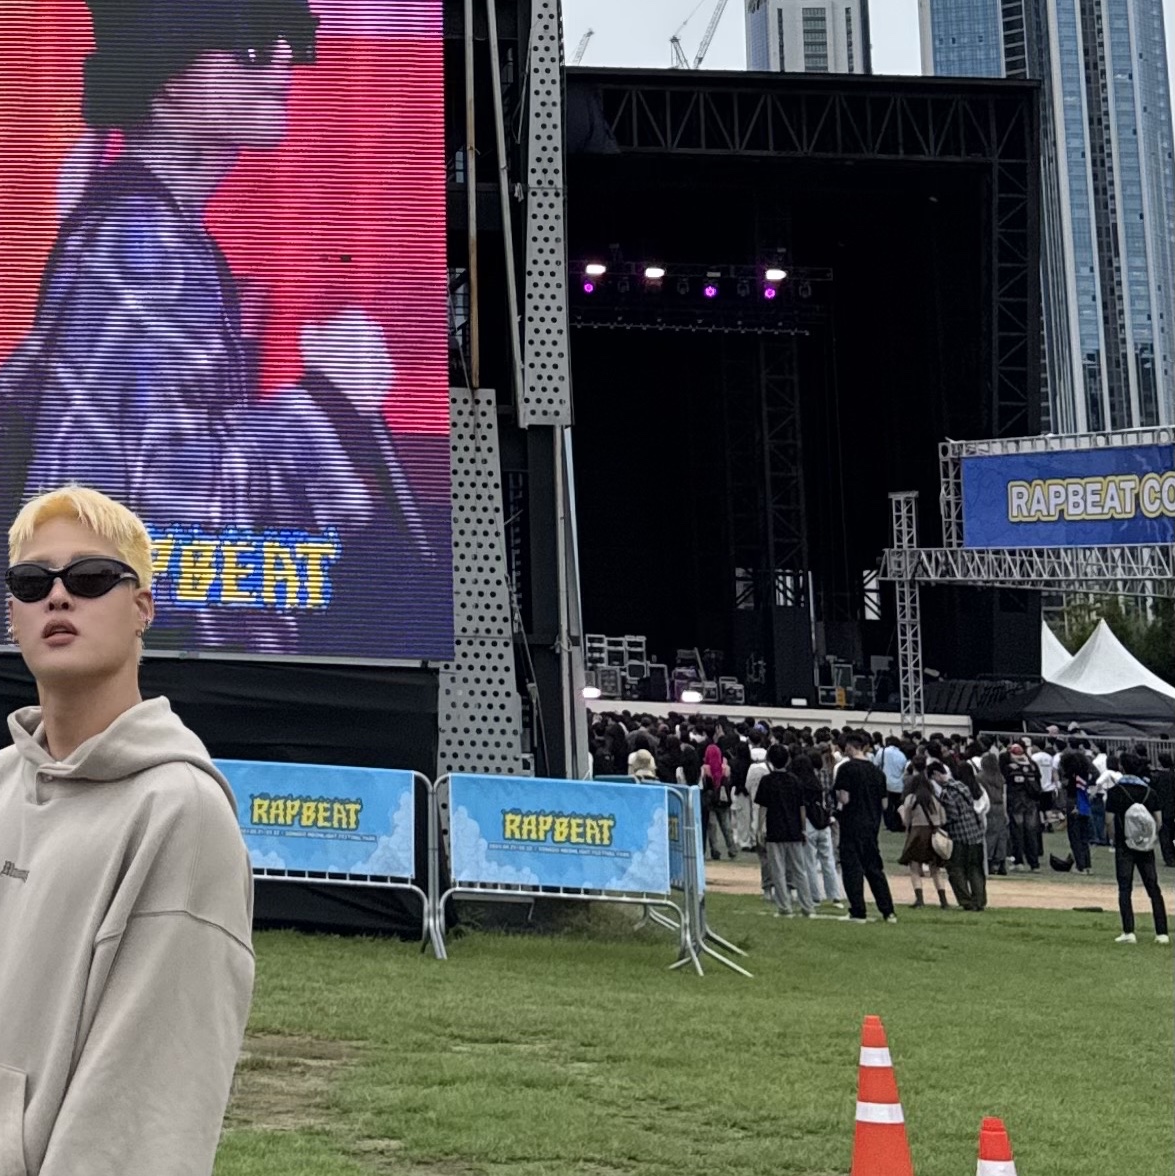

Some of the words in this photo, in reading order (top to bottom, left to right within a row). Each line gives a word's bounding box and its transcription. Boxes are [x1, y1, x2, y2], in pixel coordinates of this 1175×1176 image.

[1008, 476, 1138, 521] RAPBEAT
[250, 796, 362, 830] RAPBEAT
[503, 811, 615, 846] RAPBEAT
